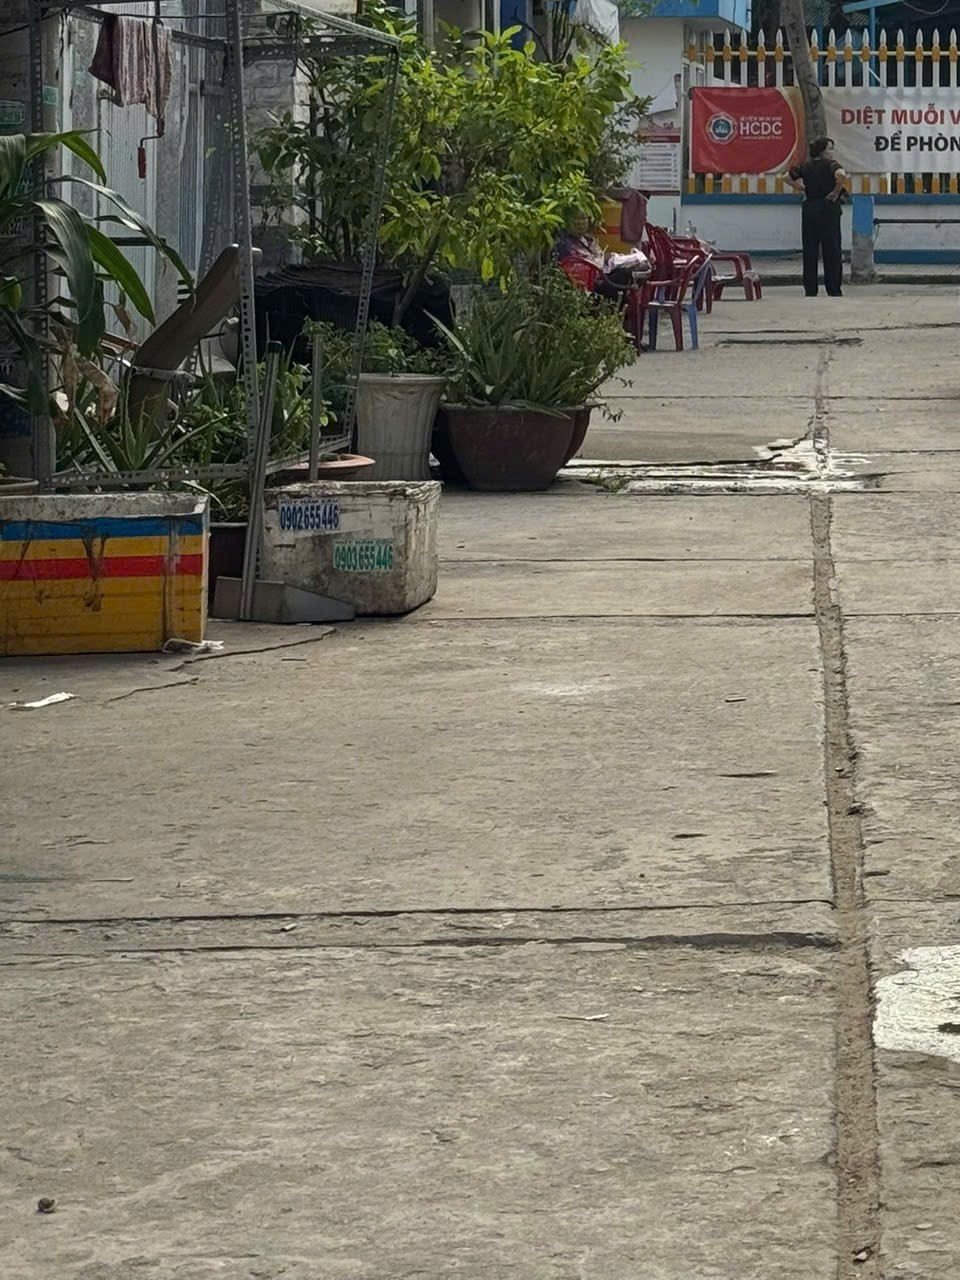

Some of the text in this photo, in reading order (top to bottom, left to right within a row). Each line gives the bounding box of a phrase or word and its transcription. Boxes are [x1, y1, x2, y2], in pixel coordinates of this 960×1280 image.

[841, 106, 886, 130] DIỆT
[891, 103, 945, 125] MUỖI
[740, 122, 782, 135] HCDC
[874, 131, 902, 151] ĐỂ
